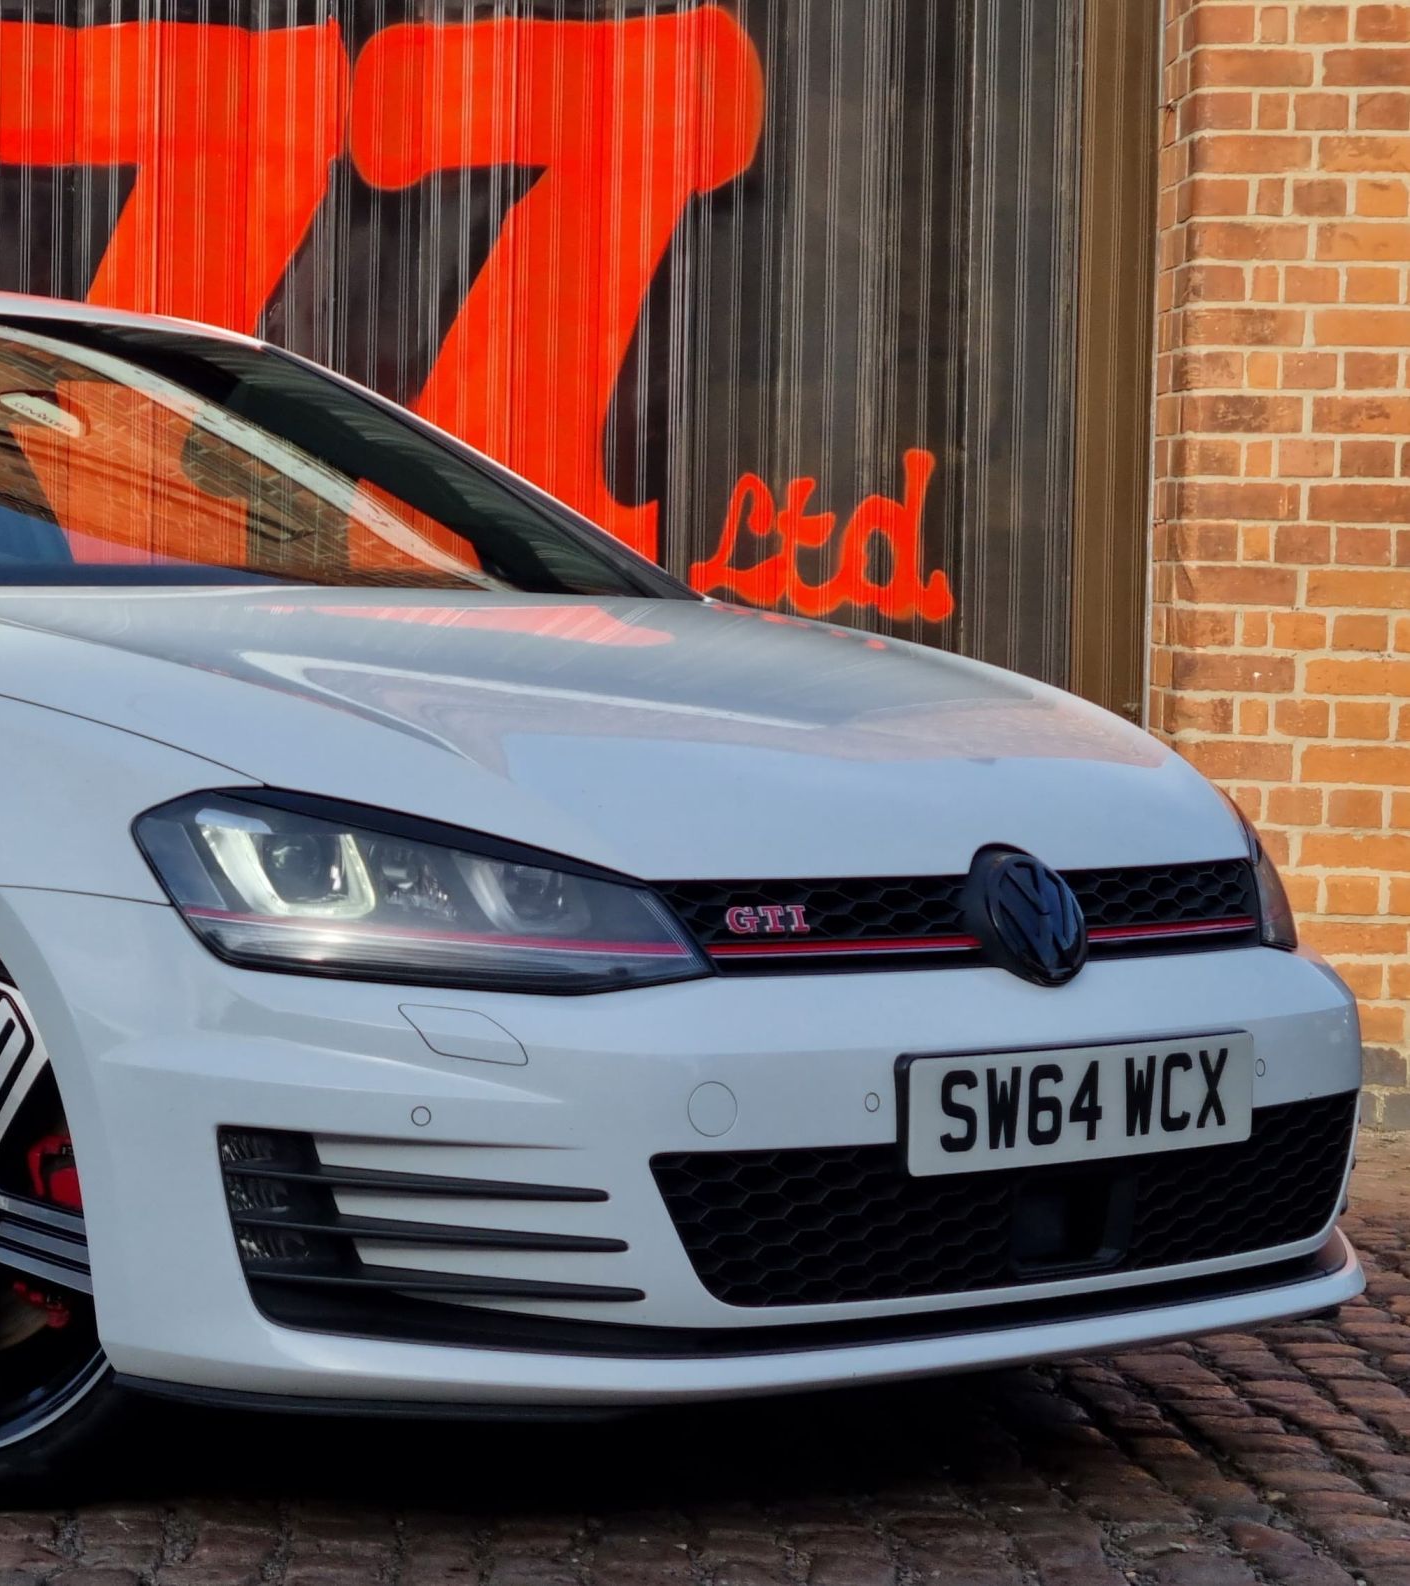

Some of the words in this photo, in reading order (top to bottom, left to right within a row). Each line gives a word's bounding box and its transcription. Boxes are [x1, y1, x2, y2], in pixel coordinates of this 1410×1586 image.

[689, 448, 954, 622] Ltd
[725, 904, 811, 935] GTI
[940, 1058, 1103, 1153] SW64
[1125, 1047, 1229, 1137] WCX
